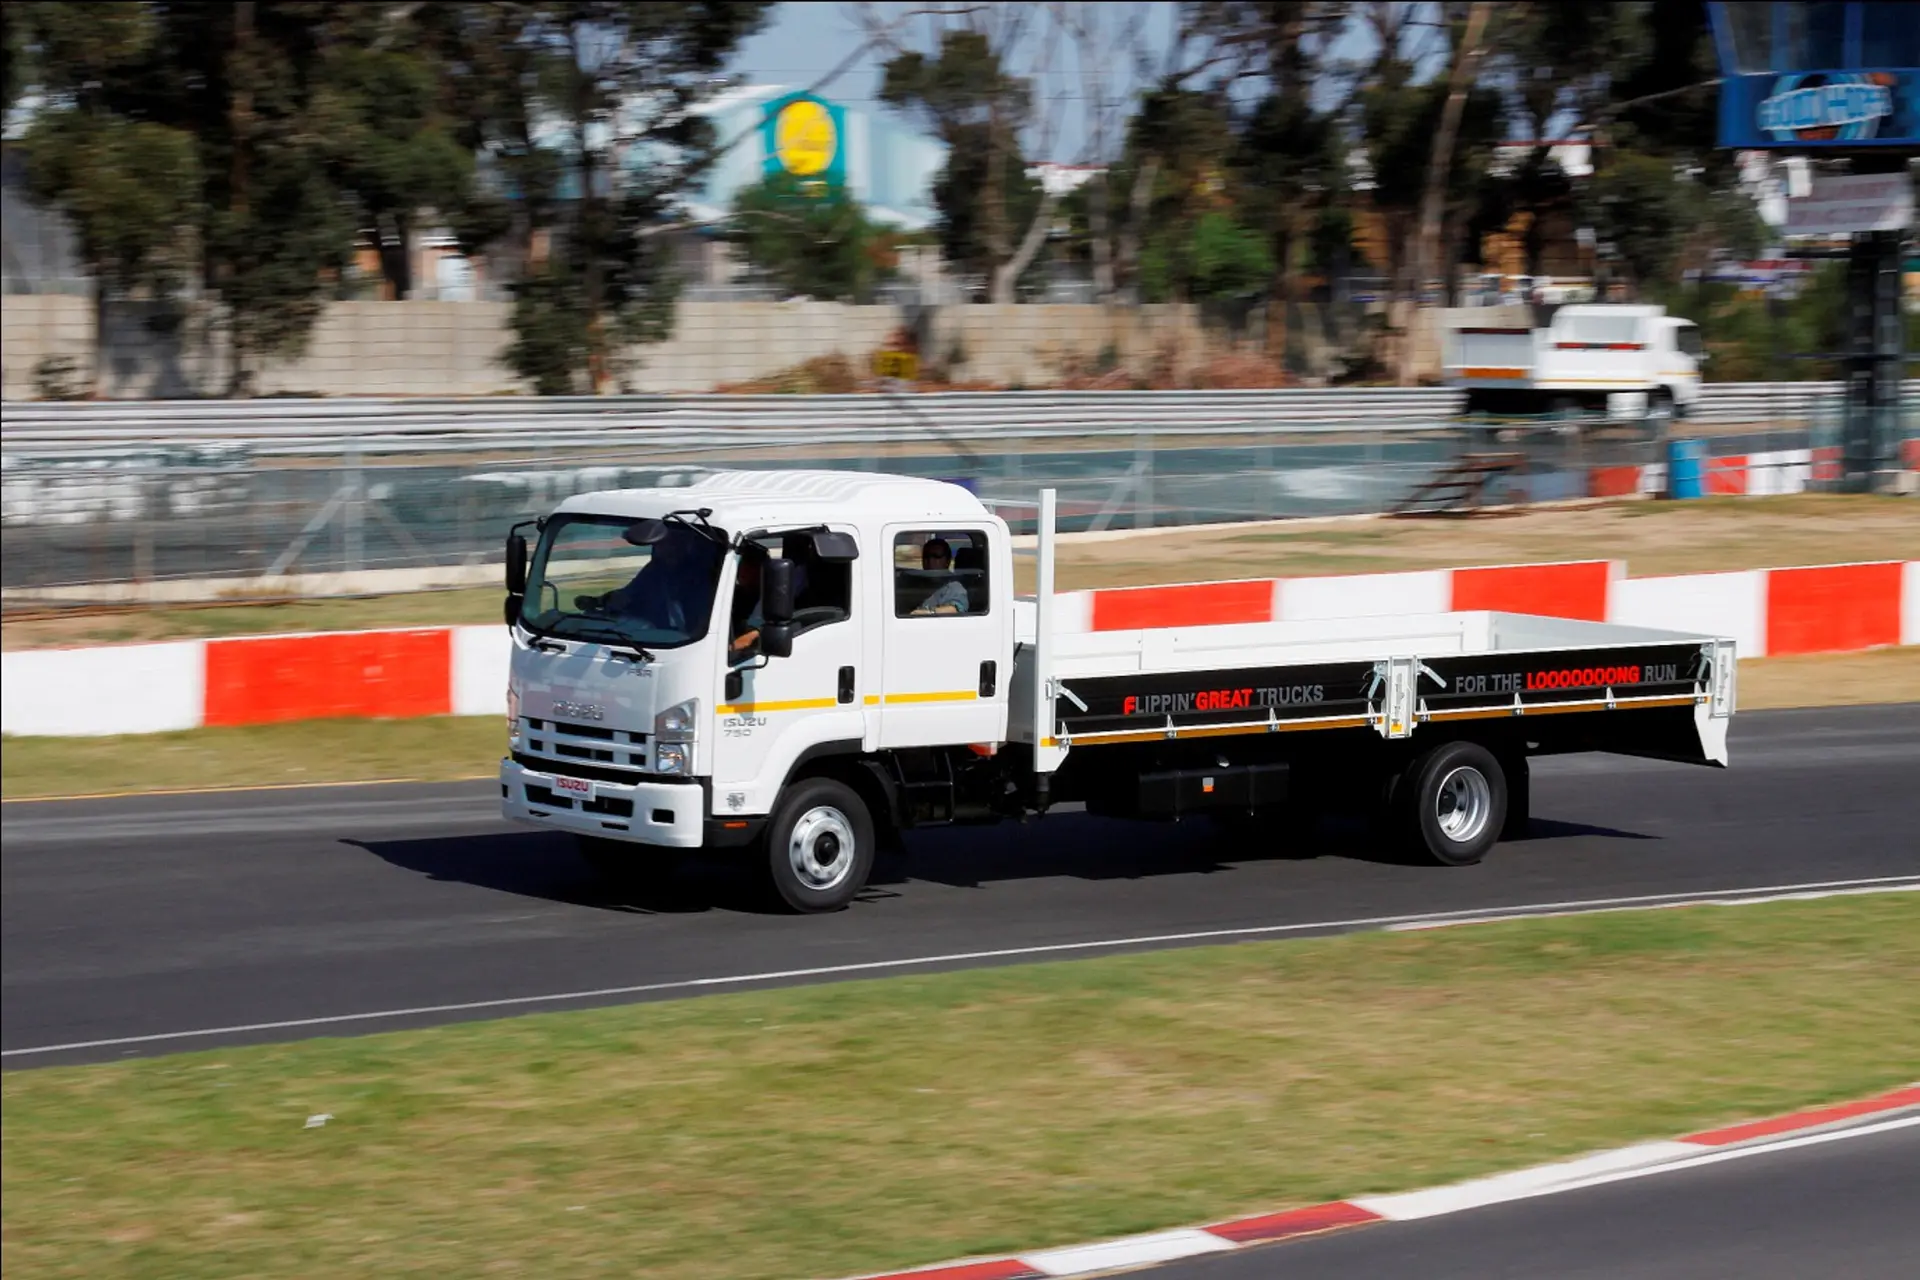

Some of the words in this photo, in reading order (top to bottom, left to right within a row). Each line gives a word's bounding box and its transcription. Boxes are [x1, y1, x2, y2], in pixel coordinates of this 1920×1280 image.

[1455, 674, 1488, 693] FOR
[1491, 672, 1522, 691] THE
[1526, 665, 1641, 690] LOOOOOOONG
[1644, 664, 1677, 682] RUN
[1256, 685, 1324, 707] TRUCKS
[723, 717, 767, 728] ISUZU
[555, 776, 589, 792] ISUZU
